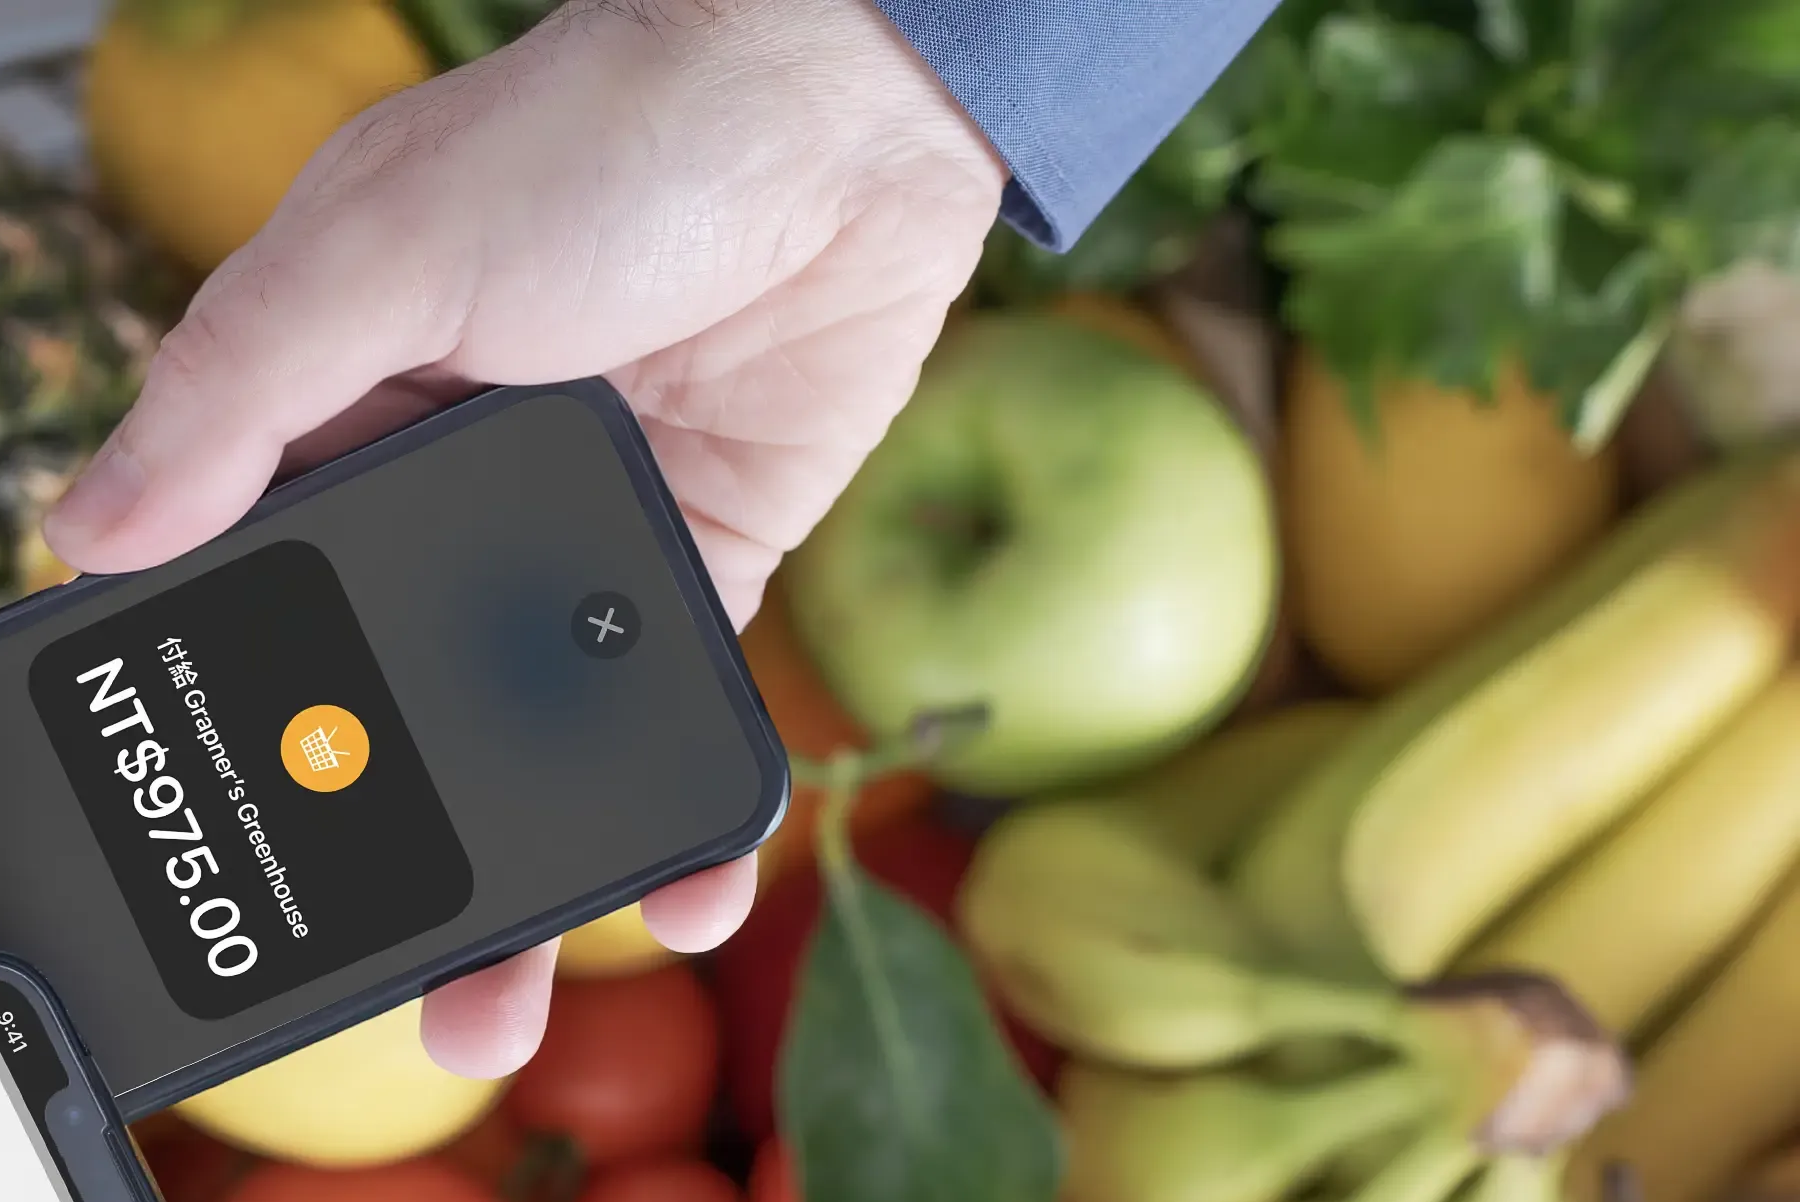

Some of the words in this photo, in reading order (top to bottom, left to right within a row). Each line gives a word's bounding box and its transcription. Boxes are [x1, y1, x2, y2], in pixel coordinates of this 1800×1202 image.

[76, 657, 258, 977] NT$975.00
[157, 637, 199, 689] 付給
[184, 689, 246, 801] Grapner's
[237, 803, 309, 938] Greenhouse
